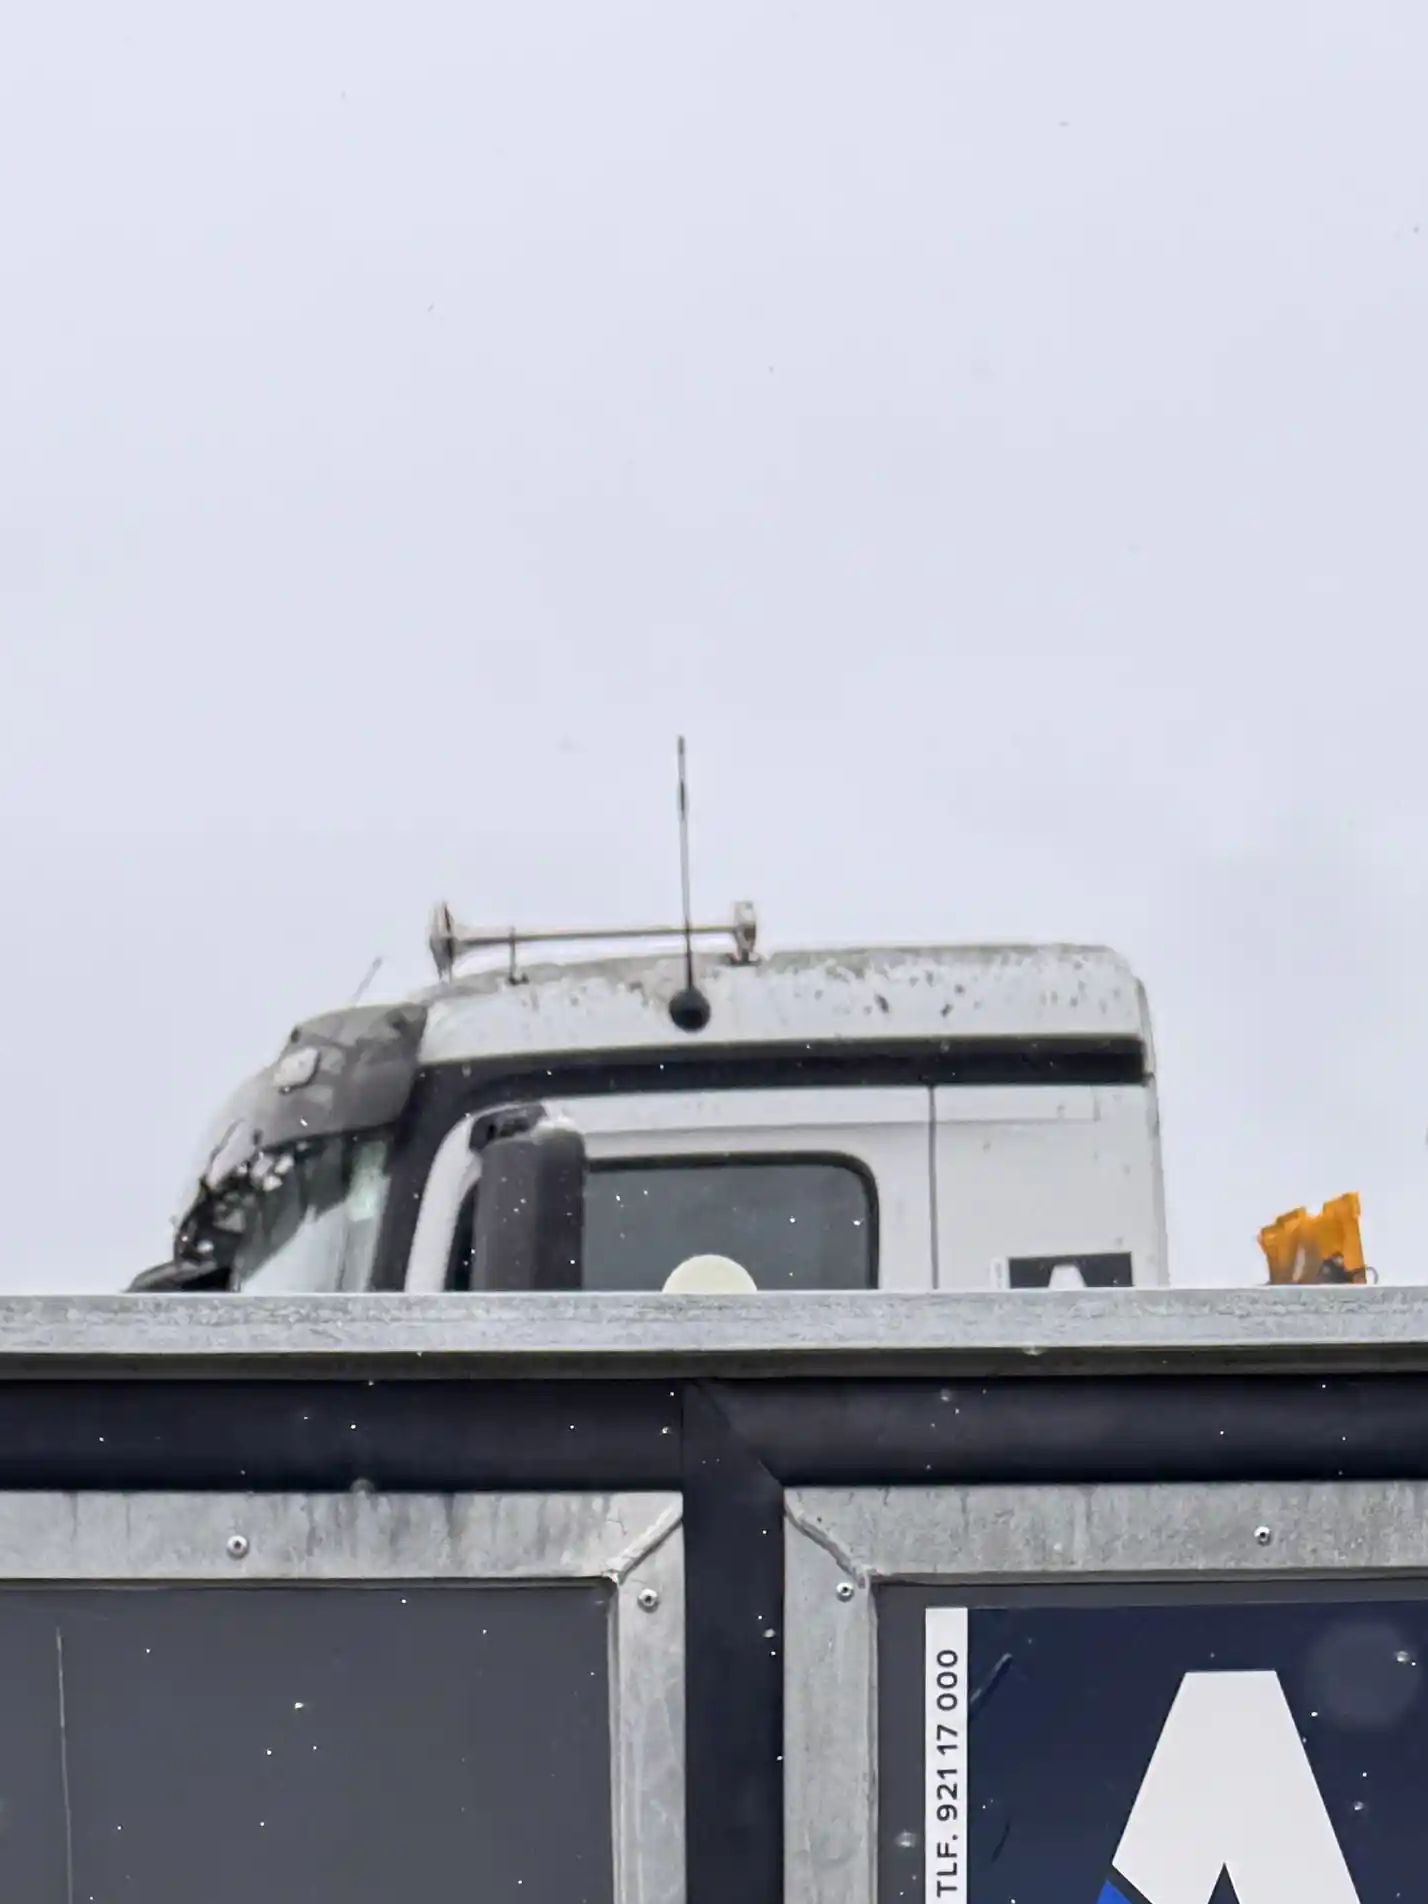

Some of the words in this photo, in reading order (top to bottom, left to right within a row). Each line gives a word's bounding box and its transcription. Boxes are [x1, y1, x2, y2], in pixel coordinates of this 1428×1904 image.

[936, 1649, 959, 1712] 000
[936, 1724, 959, 1755] 17
[936, 1768, 959, 1822] 921
[936, 1834, 959, 1898] TLF.
